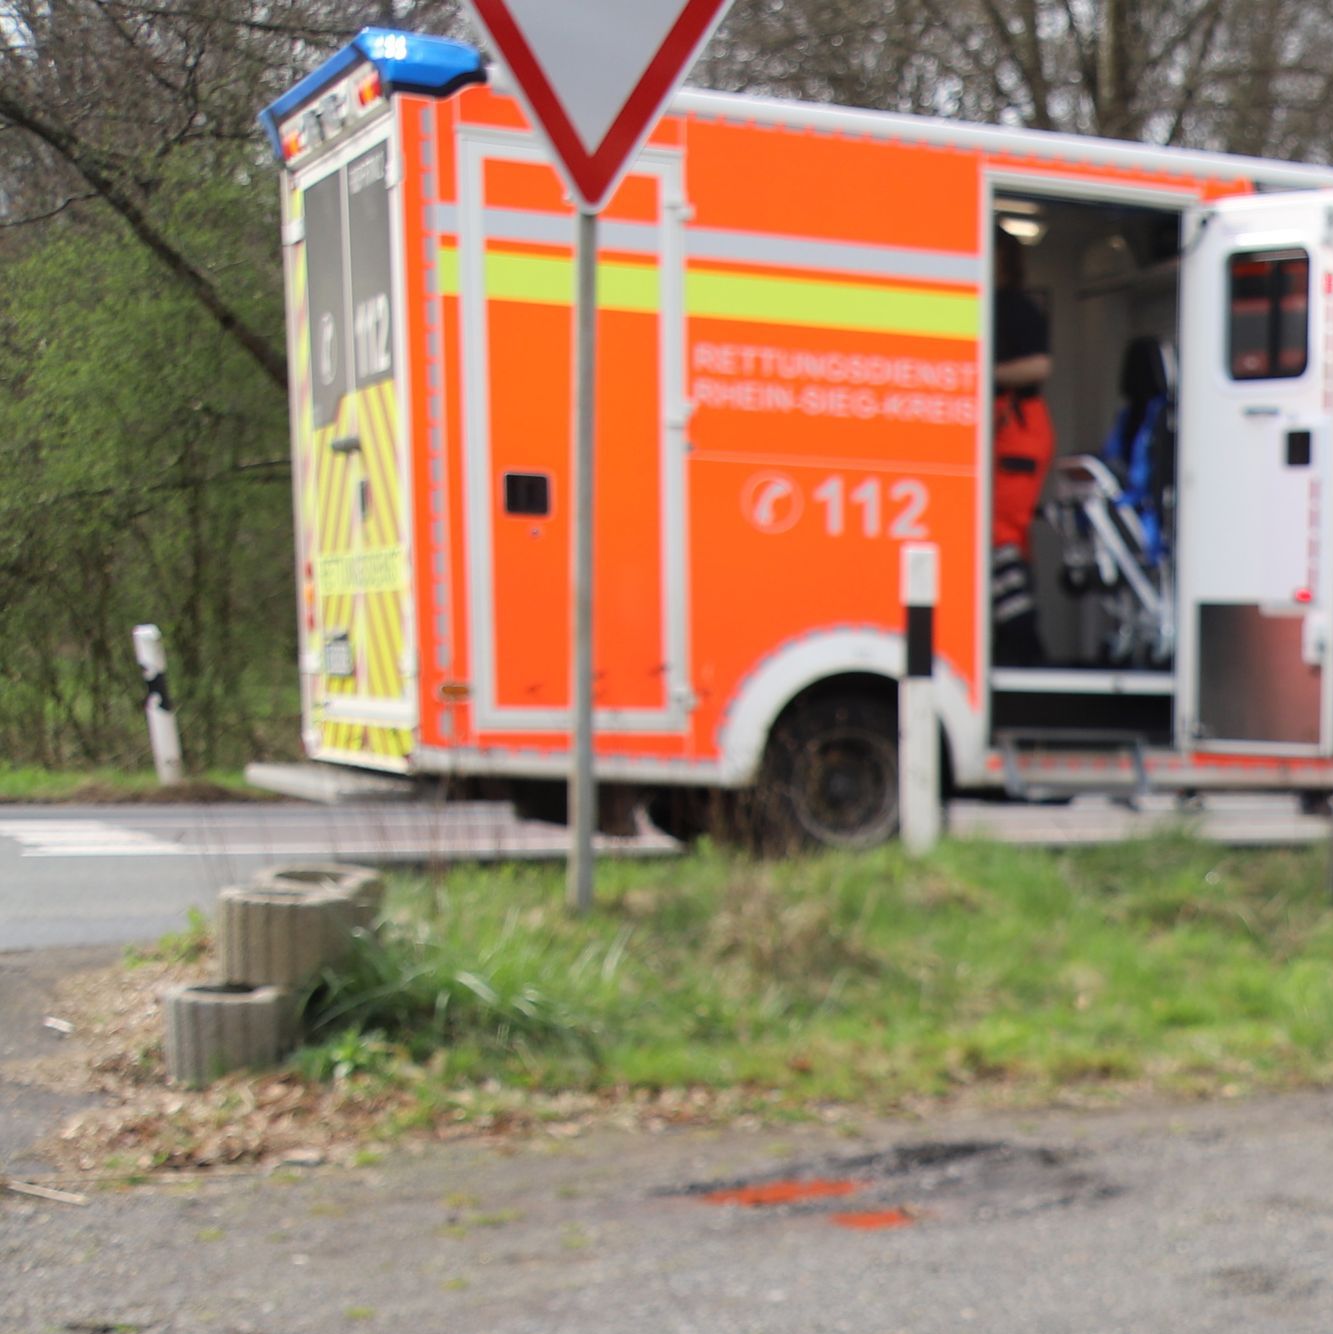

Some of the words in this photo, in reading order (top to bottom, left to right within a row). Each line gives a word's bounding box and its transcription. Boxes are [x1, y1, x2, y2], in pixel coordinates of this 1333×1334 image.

[693, 342, 979, 391] RETTUNGSDIENST
[693, 378, 978, 425] RHEIN-SIEG-KREIS
[813, 474, 930, 538] 112
